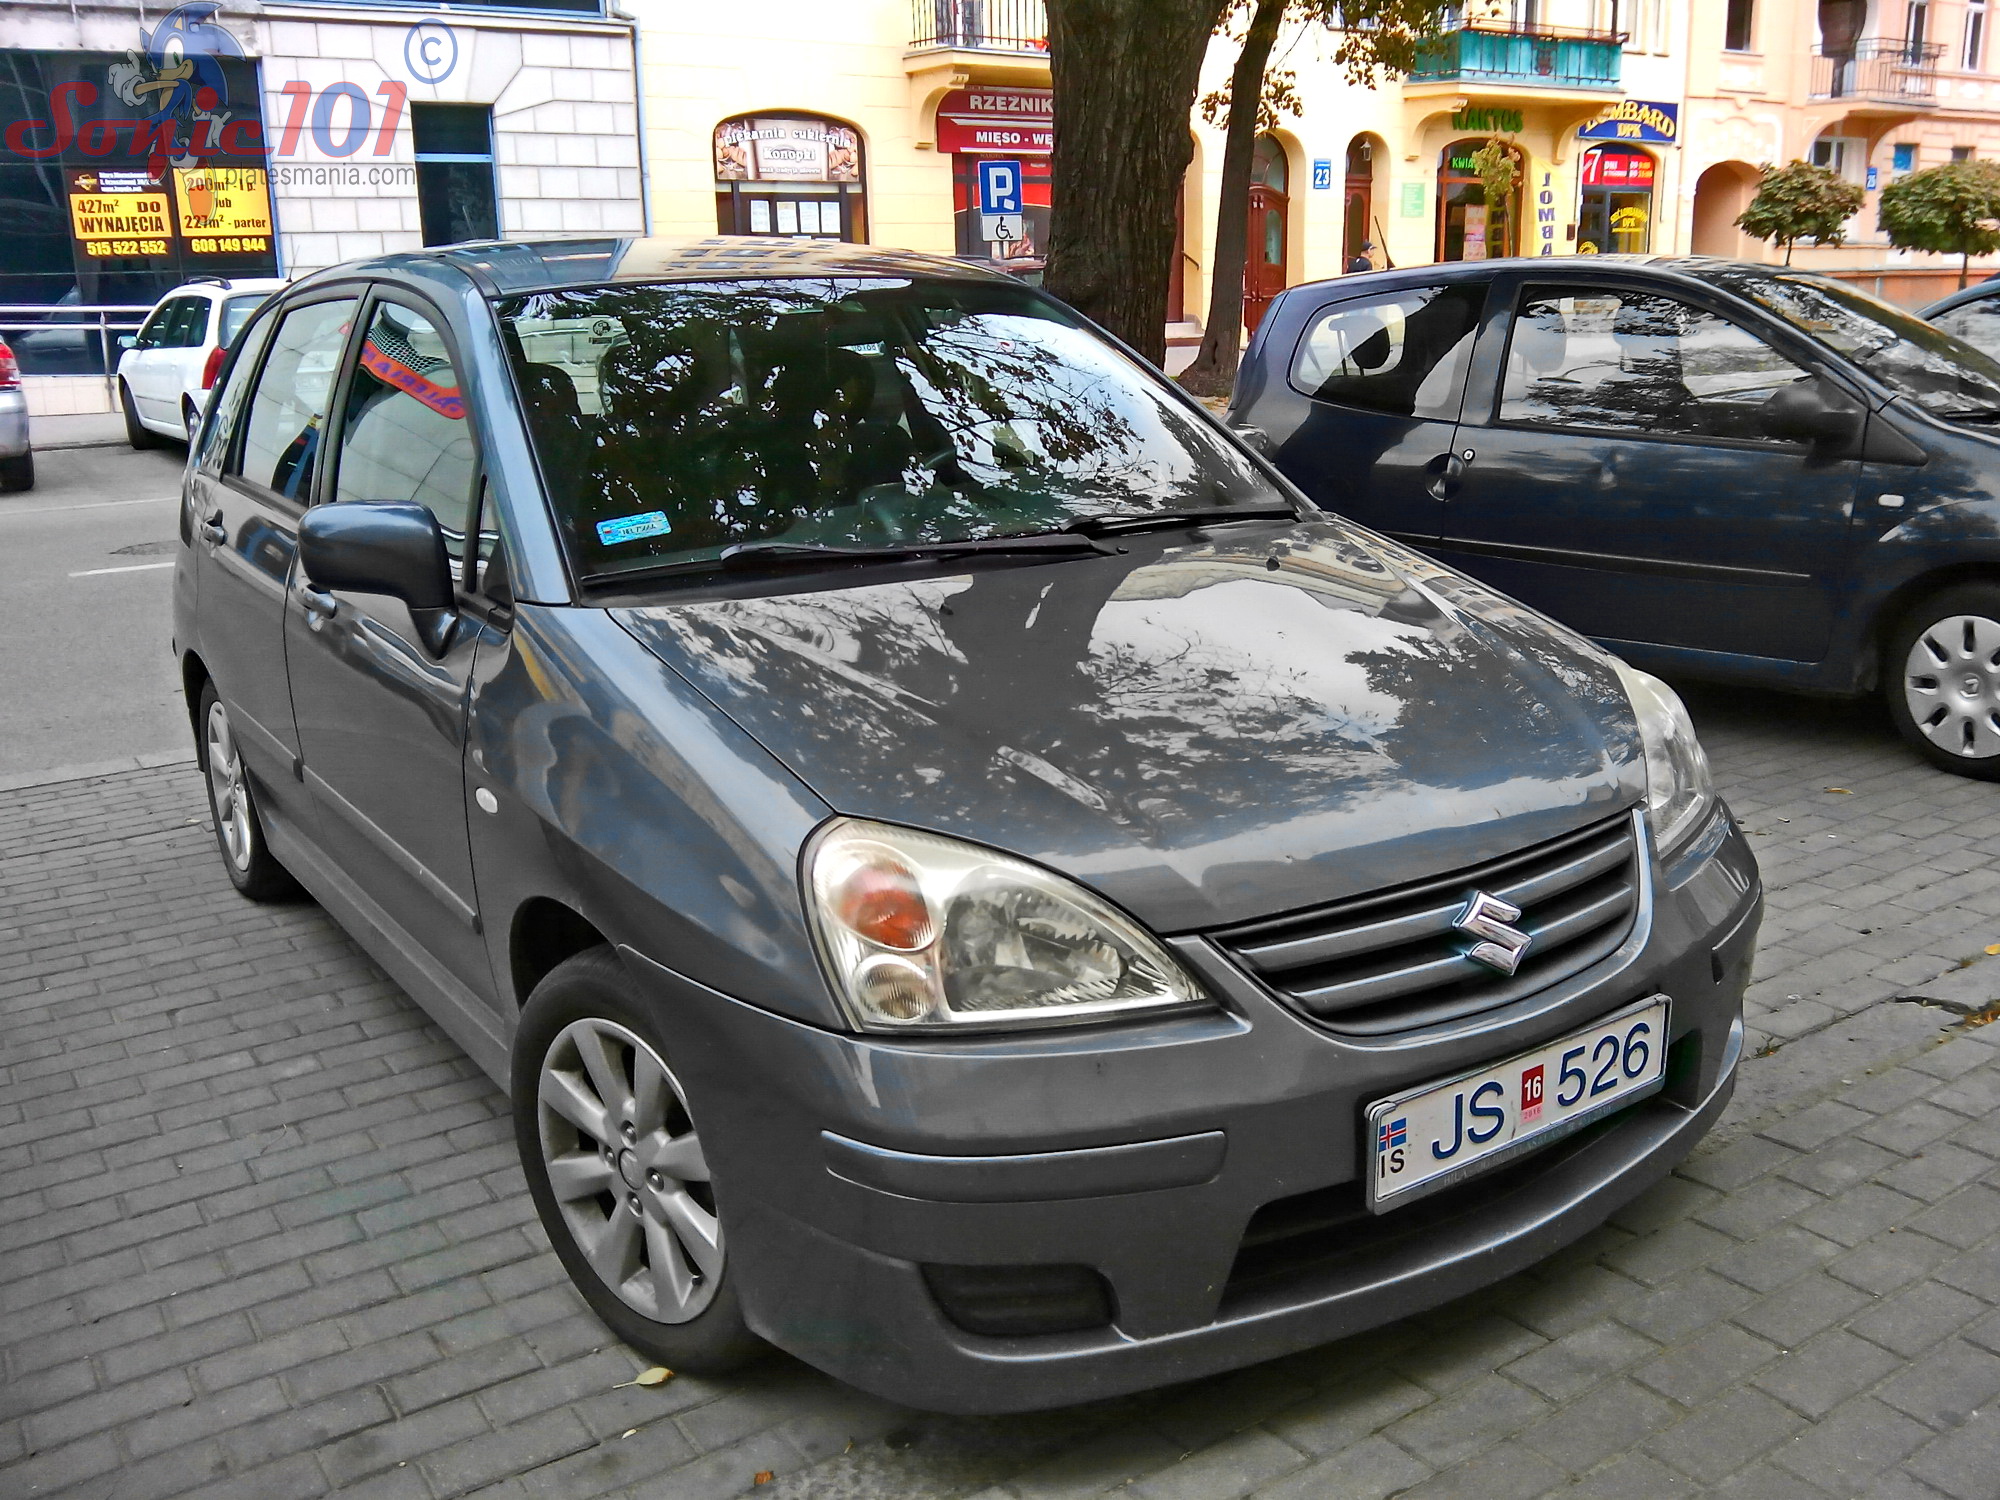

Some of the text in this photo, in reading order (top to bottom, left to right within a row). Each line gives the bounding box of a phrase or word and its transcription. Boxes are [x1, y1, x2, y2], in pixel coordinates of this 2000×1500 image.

[976, 131, 1021, 146] MIĘSO
[1617, 123, 1642, 138] DPK
[763, 147, 816, 163] Konopki
[1452, 157, 1477, 168] KWIA
[1315, 168, 1329, 184] 23
[989, 168, 1013, 208] P
[136, 201, 161, 213] DO
[79, 215, 164, 235] WYNAJĘCIA
[234, 218, 266, 229] parter
[86, 240, 167, 256] 515 522 552
[191, 238, 267, 253] 608 149 944
[1431, 1081, 1504, 1160] JS
[1557, 1021, 1651, 1107] 526
[1524, 1075, 1542, 1102] 16
[1380, 1148, 1405, 1179] IS
